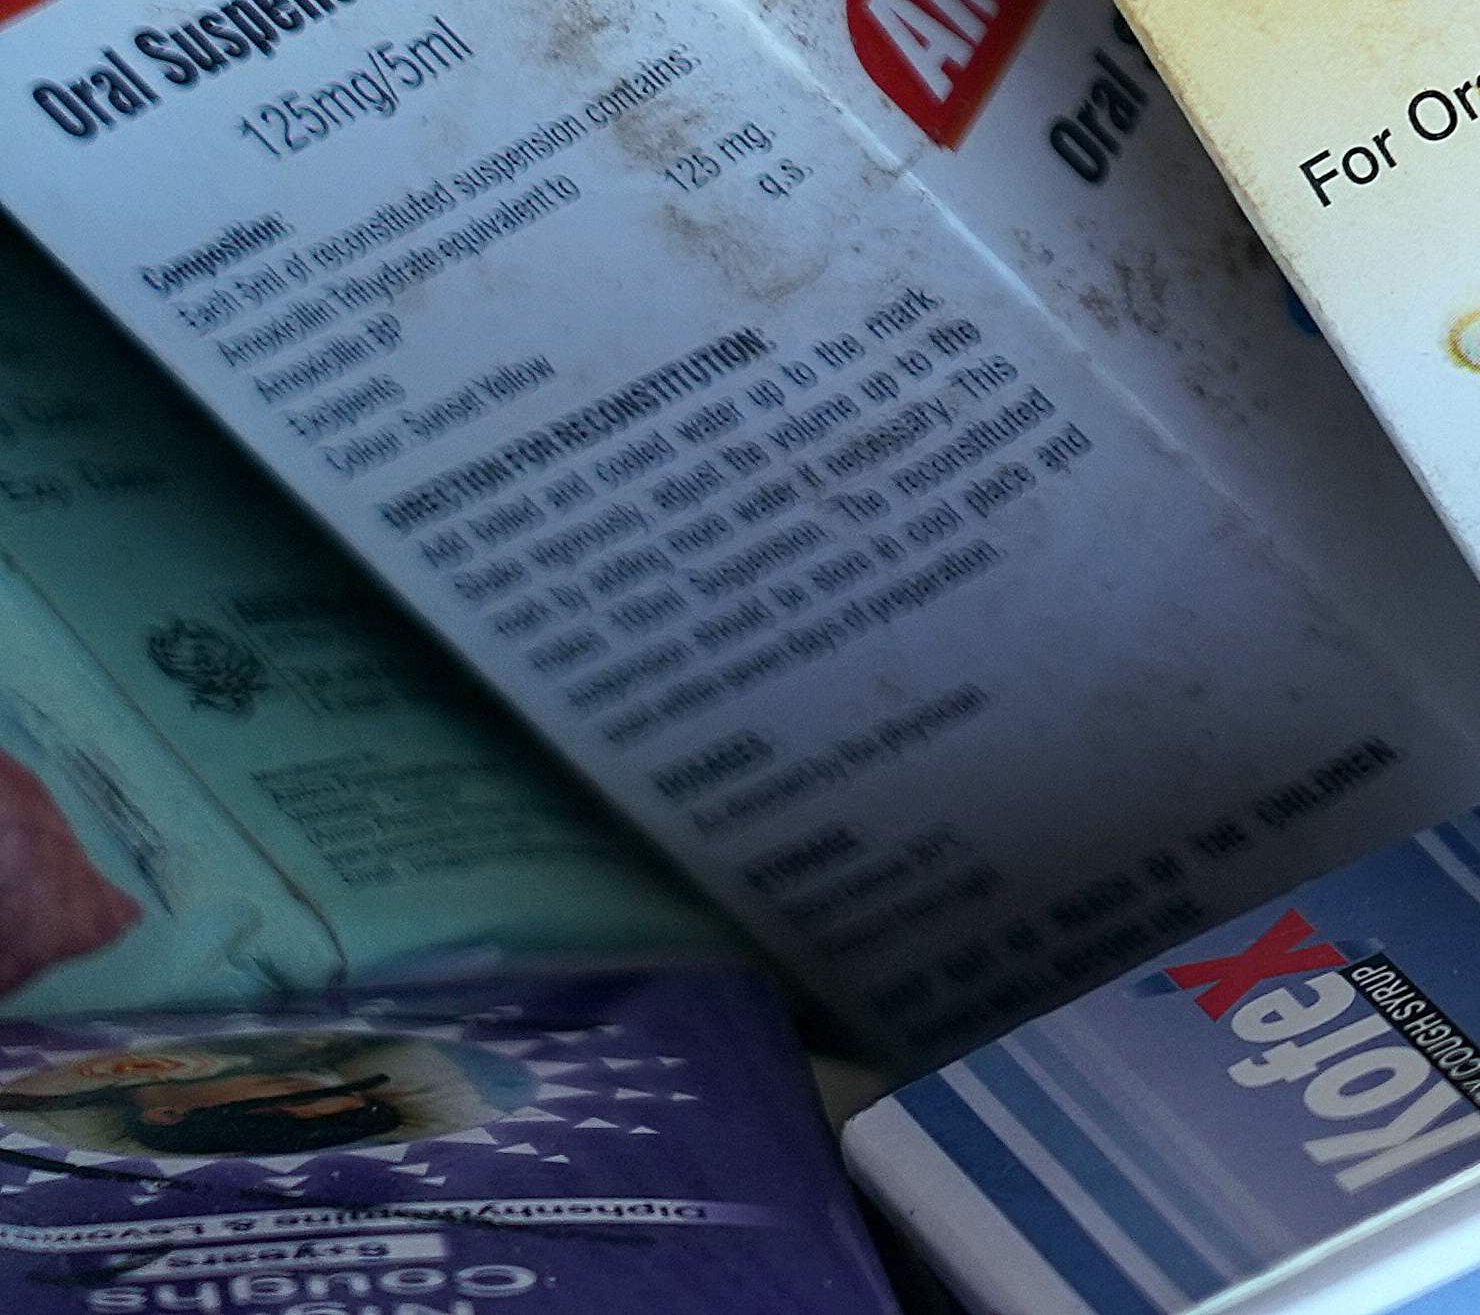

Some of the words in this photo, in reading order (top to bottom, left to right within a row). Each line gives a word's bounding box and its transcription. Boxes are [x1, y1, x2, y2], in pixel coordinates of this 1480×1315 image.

[30, 21, 177, 147] Oral
[239, 15, 474, 157] 125mg/5ml
[1299, 128, 1397, 208] For
[1347, 955, 1427, 1027] SYRUP
